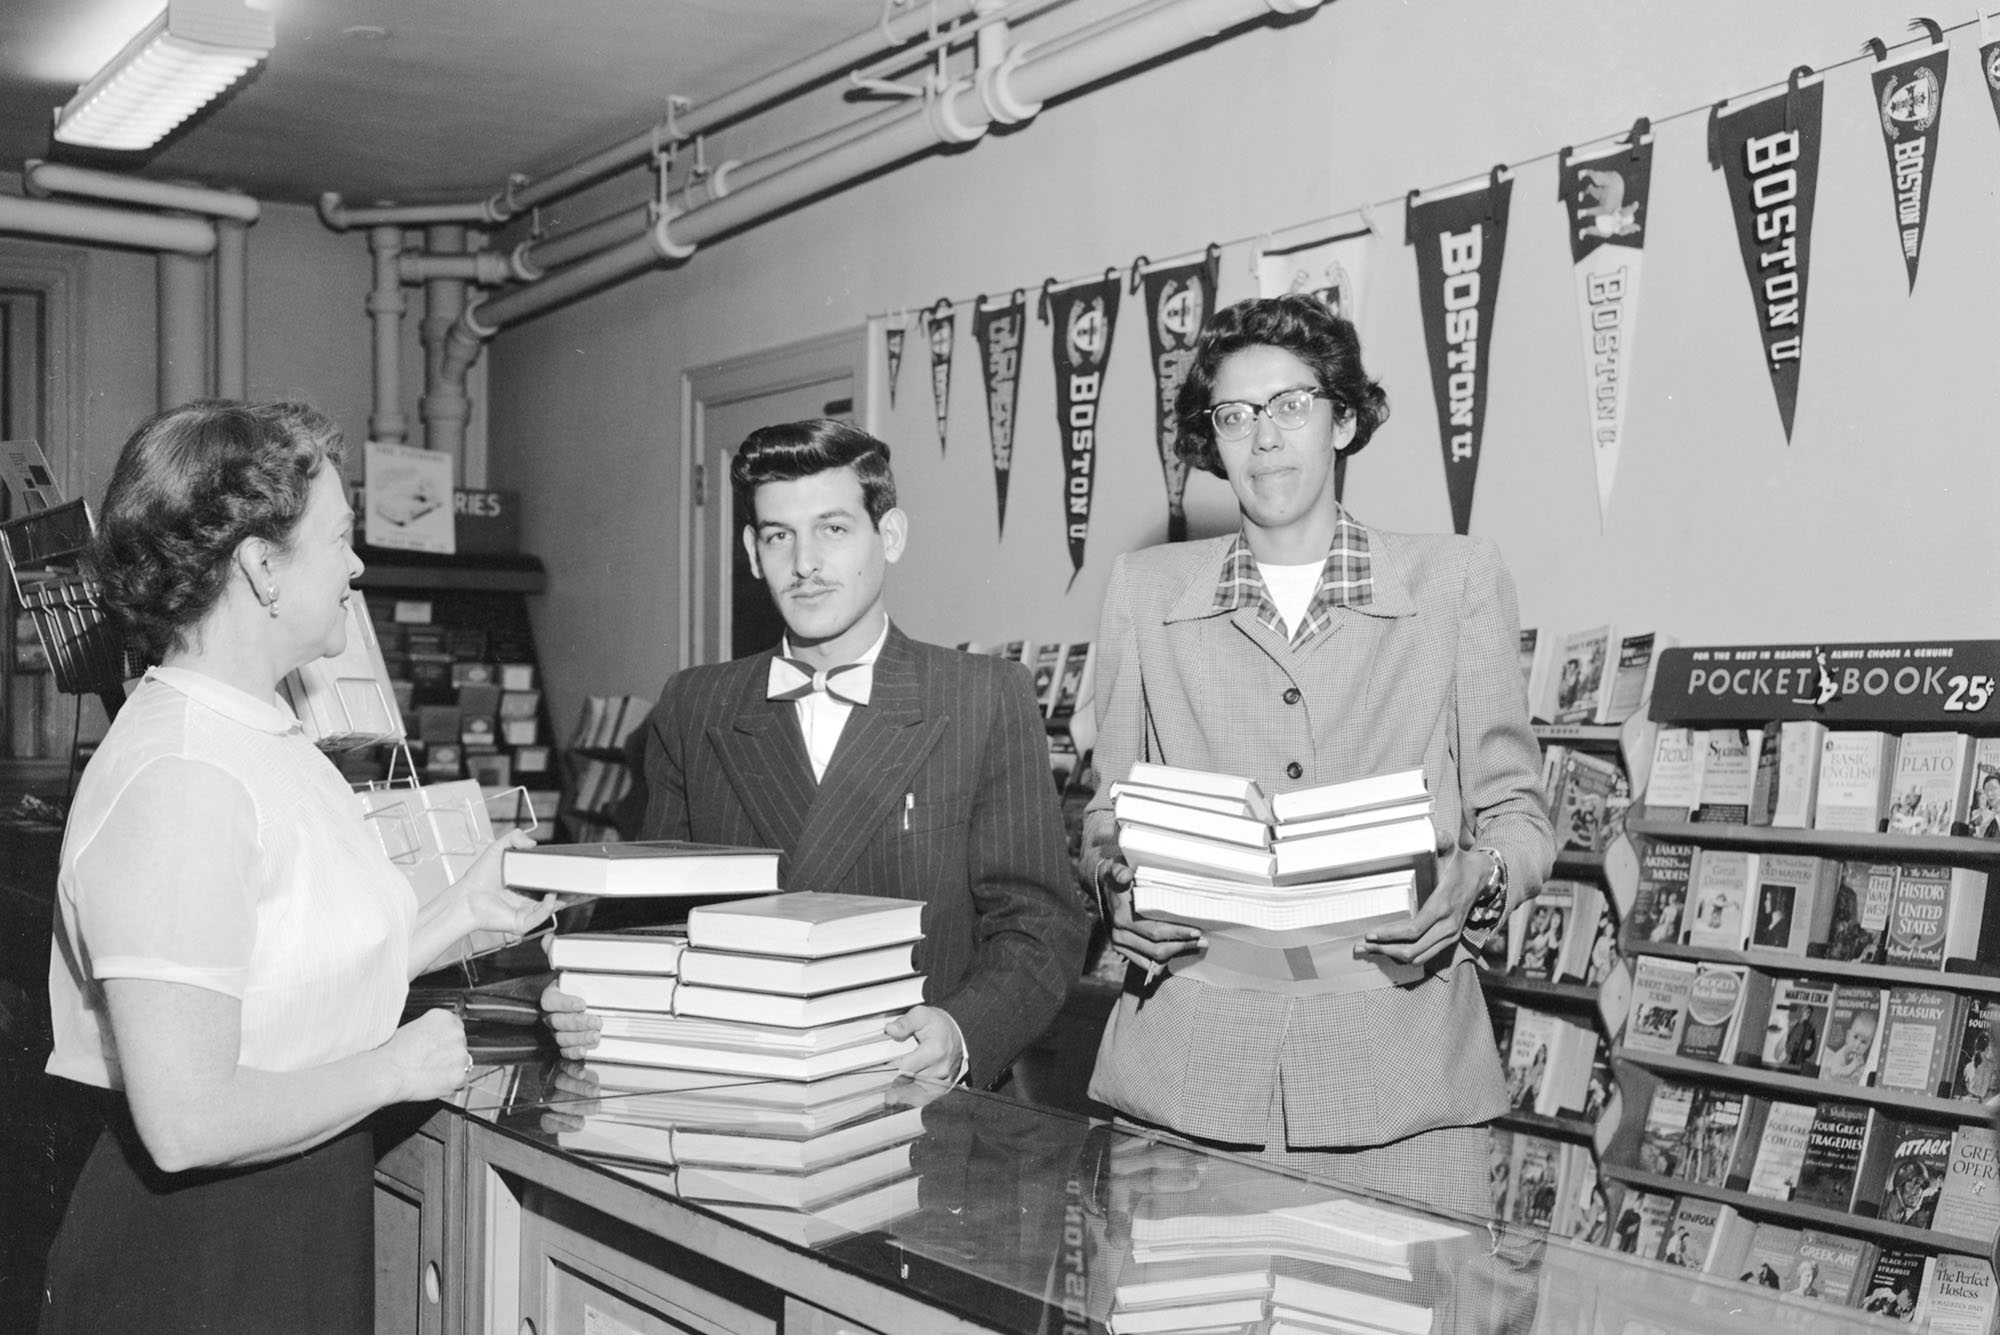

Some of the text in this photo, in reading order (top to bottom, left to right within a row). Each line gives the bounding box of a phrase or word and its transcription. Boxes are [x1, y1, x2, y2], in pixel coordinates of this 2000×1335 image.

[1894, 135, 1926, 226] BOSTON
[1747, 130, 1801, 370] BOSTON U.
[1439, 223, 1483, 463] BOSTON U.
[1586, 264, 1628, 420] BOSTON
[1069, 370, 1100, 545] BOSTON U.
[1693, 647, 1954, 661] FOR THE BEST IN READING ALWAYS CHOOSE A GENUINE
[1688, 665, 1948, 696] POCKET BOOK
[1943, 674, 1996, 712] 25¢
[1831, 753, 1869, 765] BASIC
[1901, 755, 1954, 773] PLATO
[1822, 766, 1875, 779] ENGLISH
[1655, 844, 1692, 857] FAMOUS
[1652, 868, 1689, 881] MODELS
[1872, 877, 1890, 890] THE
[1898, 881, 1945, 901] HISTORY
[1897, 901, 1944, 920] UNITED
[1896, 918, 1939, 936] STATES
[1890, 1005, 1945, 1020] TREASURY
[1813, 1120, 1867, 1136] FOUR GREAT
[1809, 1133, 1863, 1151] TRAGEDIES
[1895, 1138, 1951, 1158] ATTACK
[1679, 1210, 1717, 1227] KINFOLK
[1800, 1244, 1835, 1263] GREEK
[1834, 1252, 1858, 1267] ART
[1936, 1268, 1989, 1287] The Perfect
[1939, 1282, 1980, 1299] Hostess
